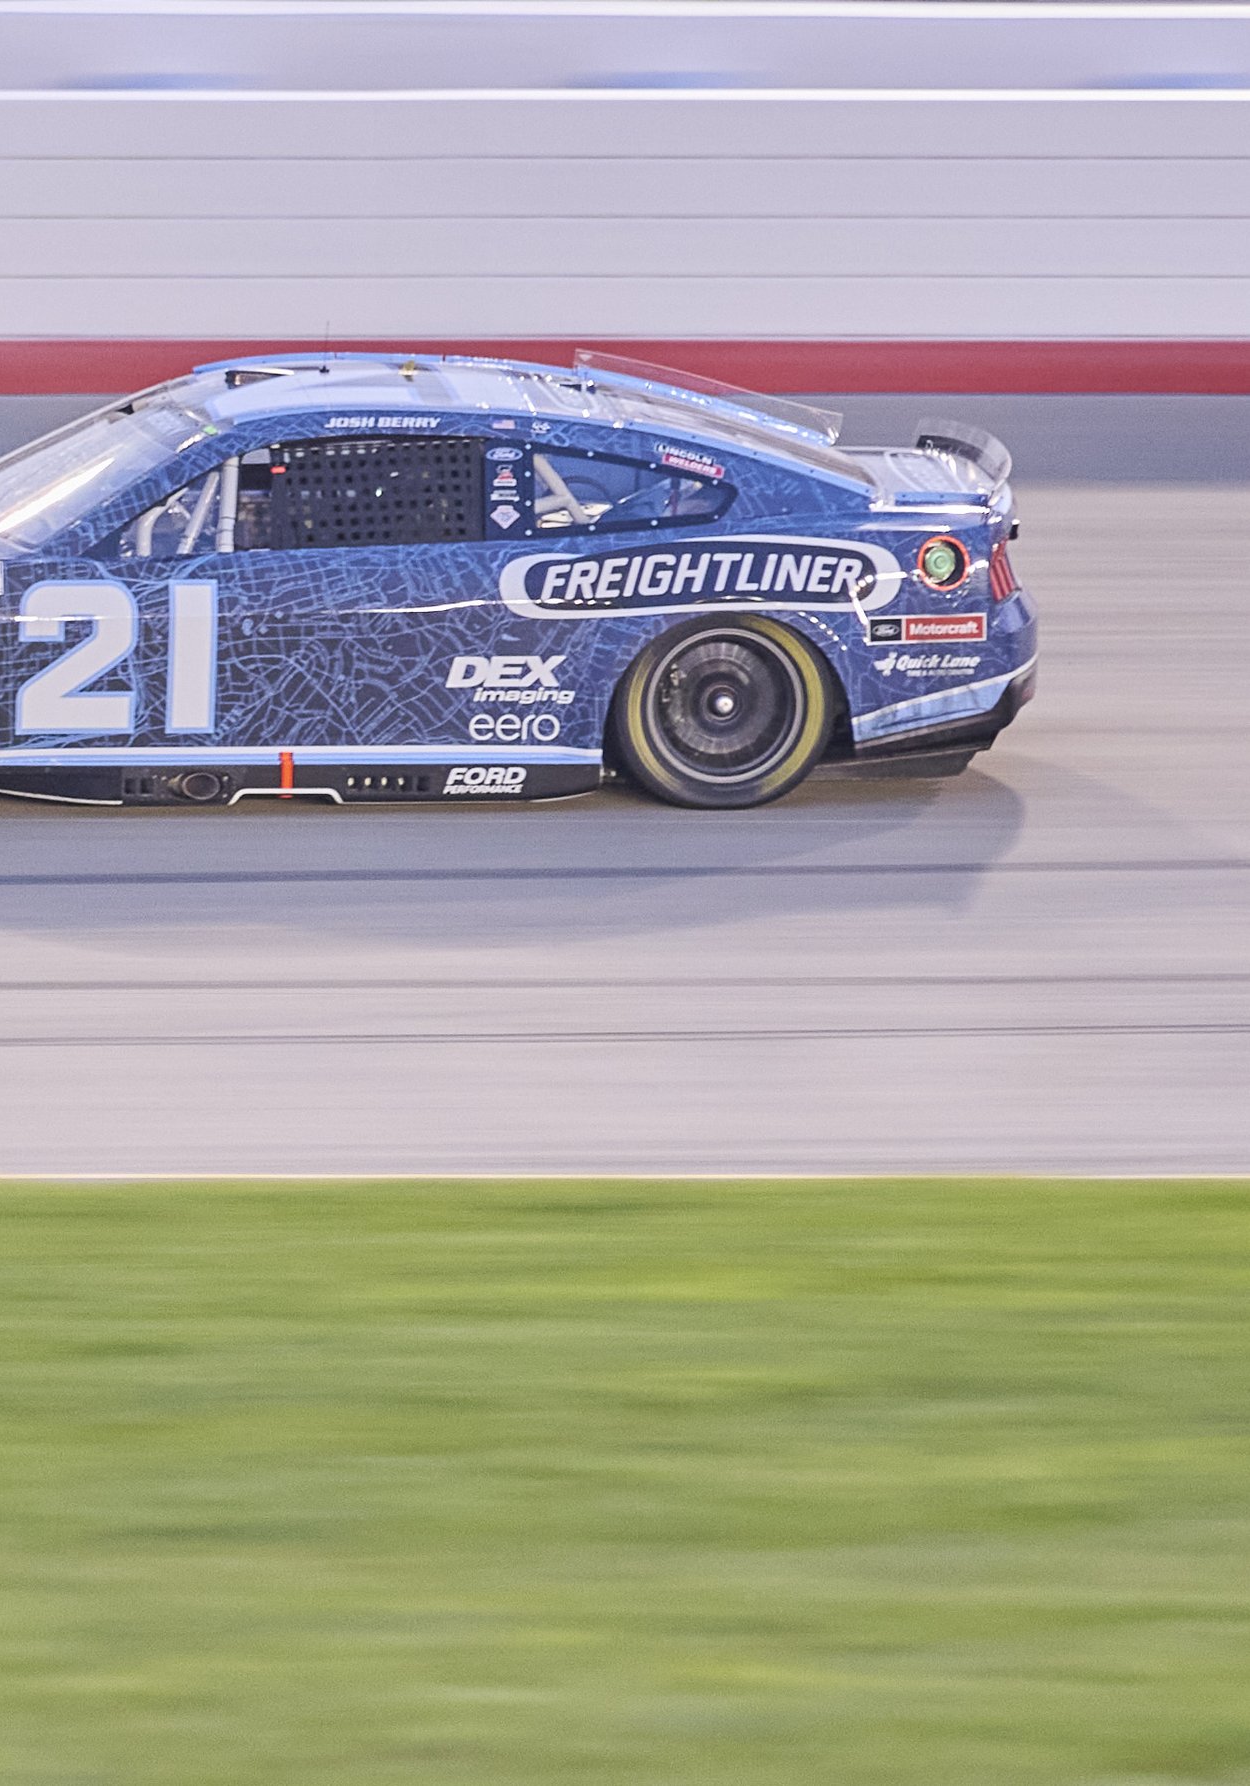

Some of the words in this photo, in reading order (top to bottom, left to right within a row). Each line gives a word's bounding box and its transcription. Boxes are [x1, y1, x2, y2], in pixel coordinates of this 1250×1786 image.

[324, 417, 375, 428] JOSH
[377, 417, 441, 428] BERRY
[656, 443, 713, 466] LINCOLN
[668, 455, 718, 475] WELDERS
[541, 553, 863, 601] FREIGHTLINER
[910, 621, 979, 635] Motorcraft
[15, 579, 218, 735] 21
[896, 655, 941, 671] Quick
[941, 655, 981, 669] Lane
[446, 655, 567, 688] DEX
[473, 687, 576, 704] imaging
[468, 713, 561, 741] eero
[446, 767, 527, 785] FORD
[442, 784, 524, 795] PERFORMANCE
